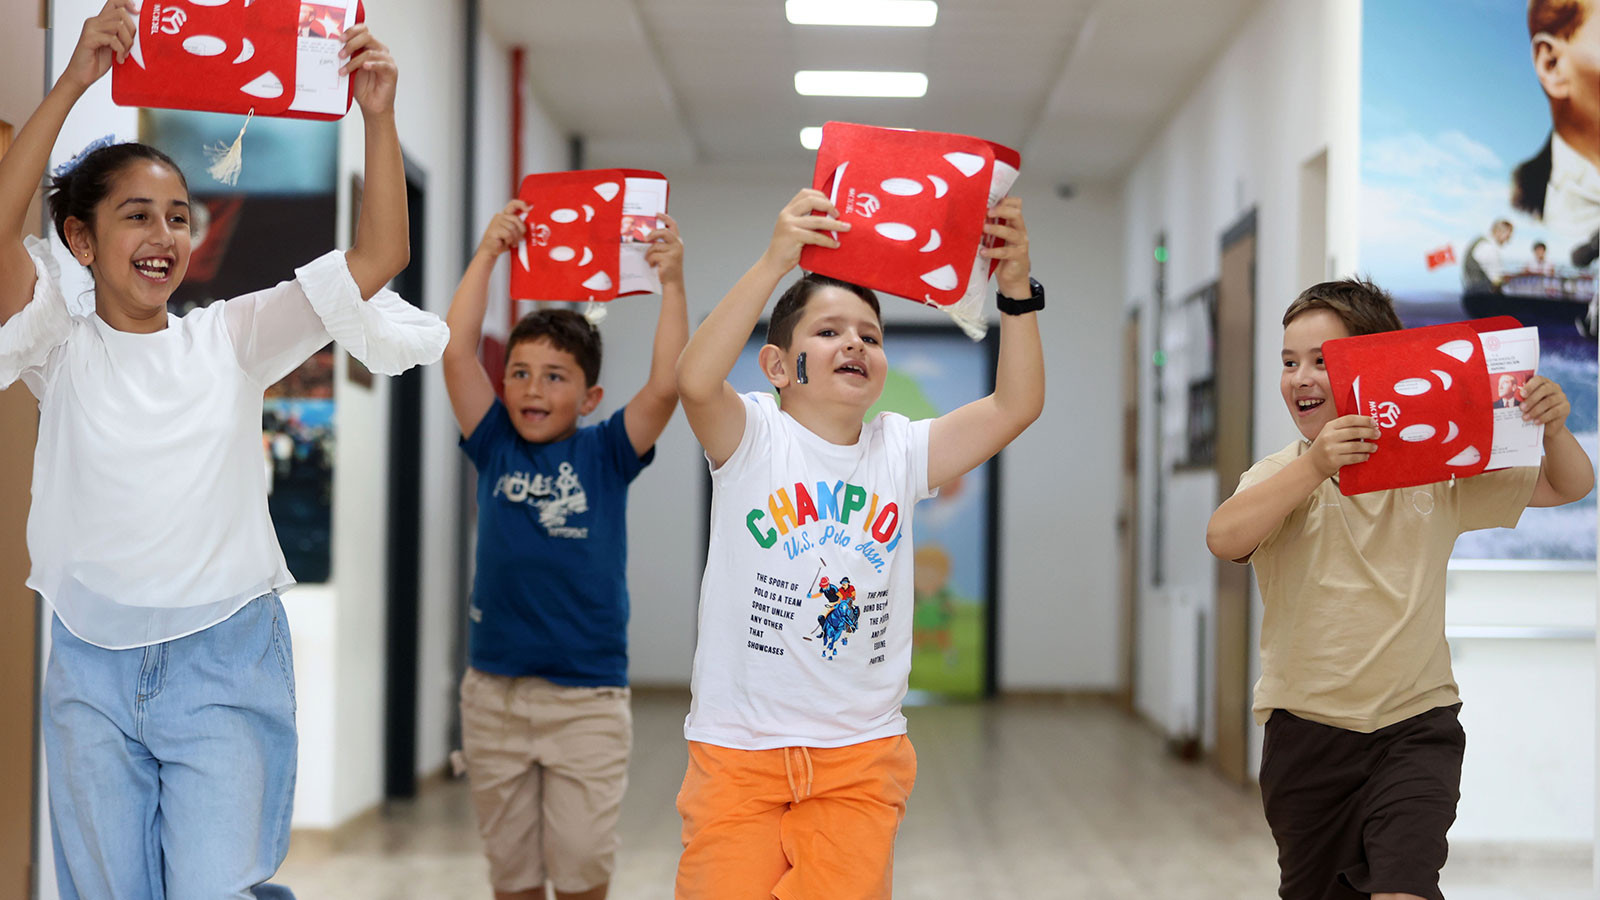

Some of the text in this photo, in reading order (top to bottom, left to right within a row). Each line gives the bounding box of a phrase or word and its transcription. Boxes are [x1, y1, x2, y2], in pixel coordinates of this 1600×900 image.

[151, 4, 160, 35] MODEL
[784, 531, 814, 560] U.S.
[855, 541, 885, 573] Assn.
[756, 572, 799, 591] THE SPORT OF
[753, 587, 769, 599] POLO
[769, 592, 776, 601] IS
[784, 596, 802, 607] TEAM
[752, 600, 795, 620] SPORT UNLIKE
[750, 614, 783, 631] ANY OTHER
[869, 617, 879, 626] THE
[749, 627, 764, 638] THAT
[747, 640, 784, 656] SHOWCASES
